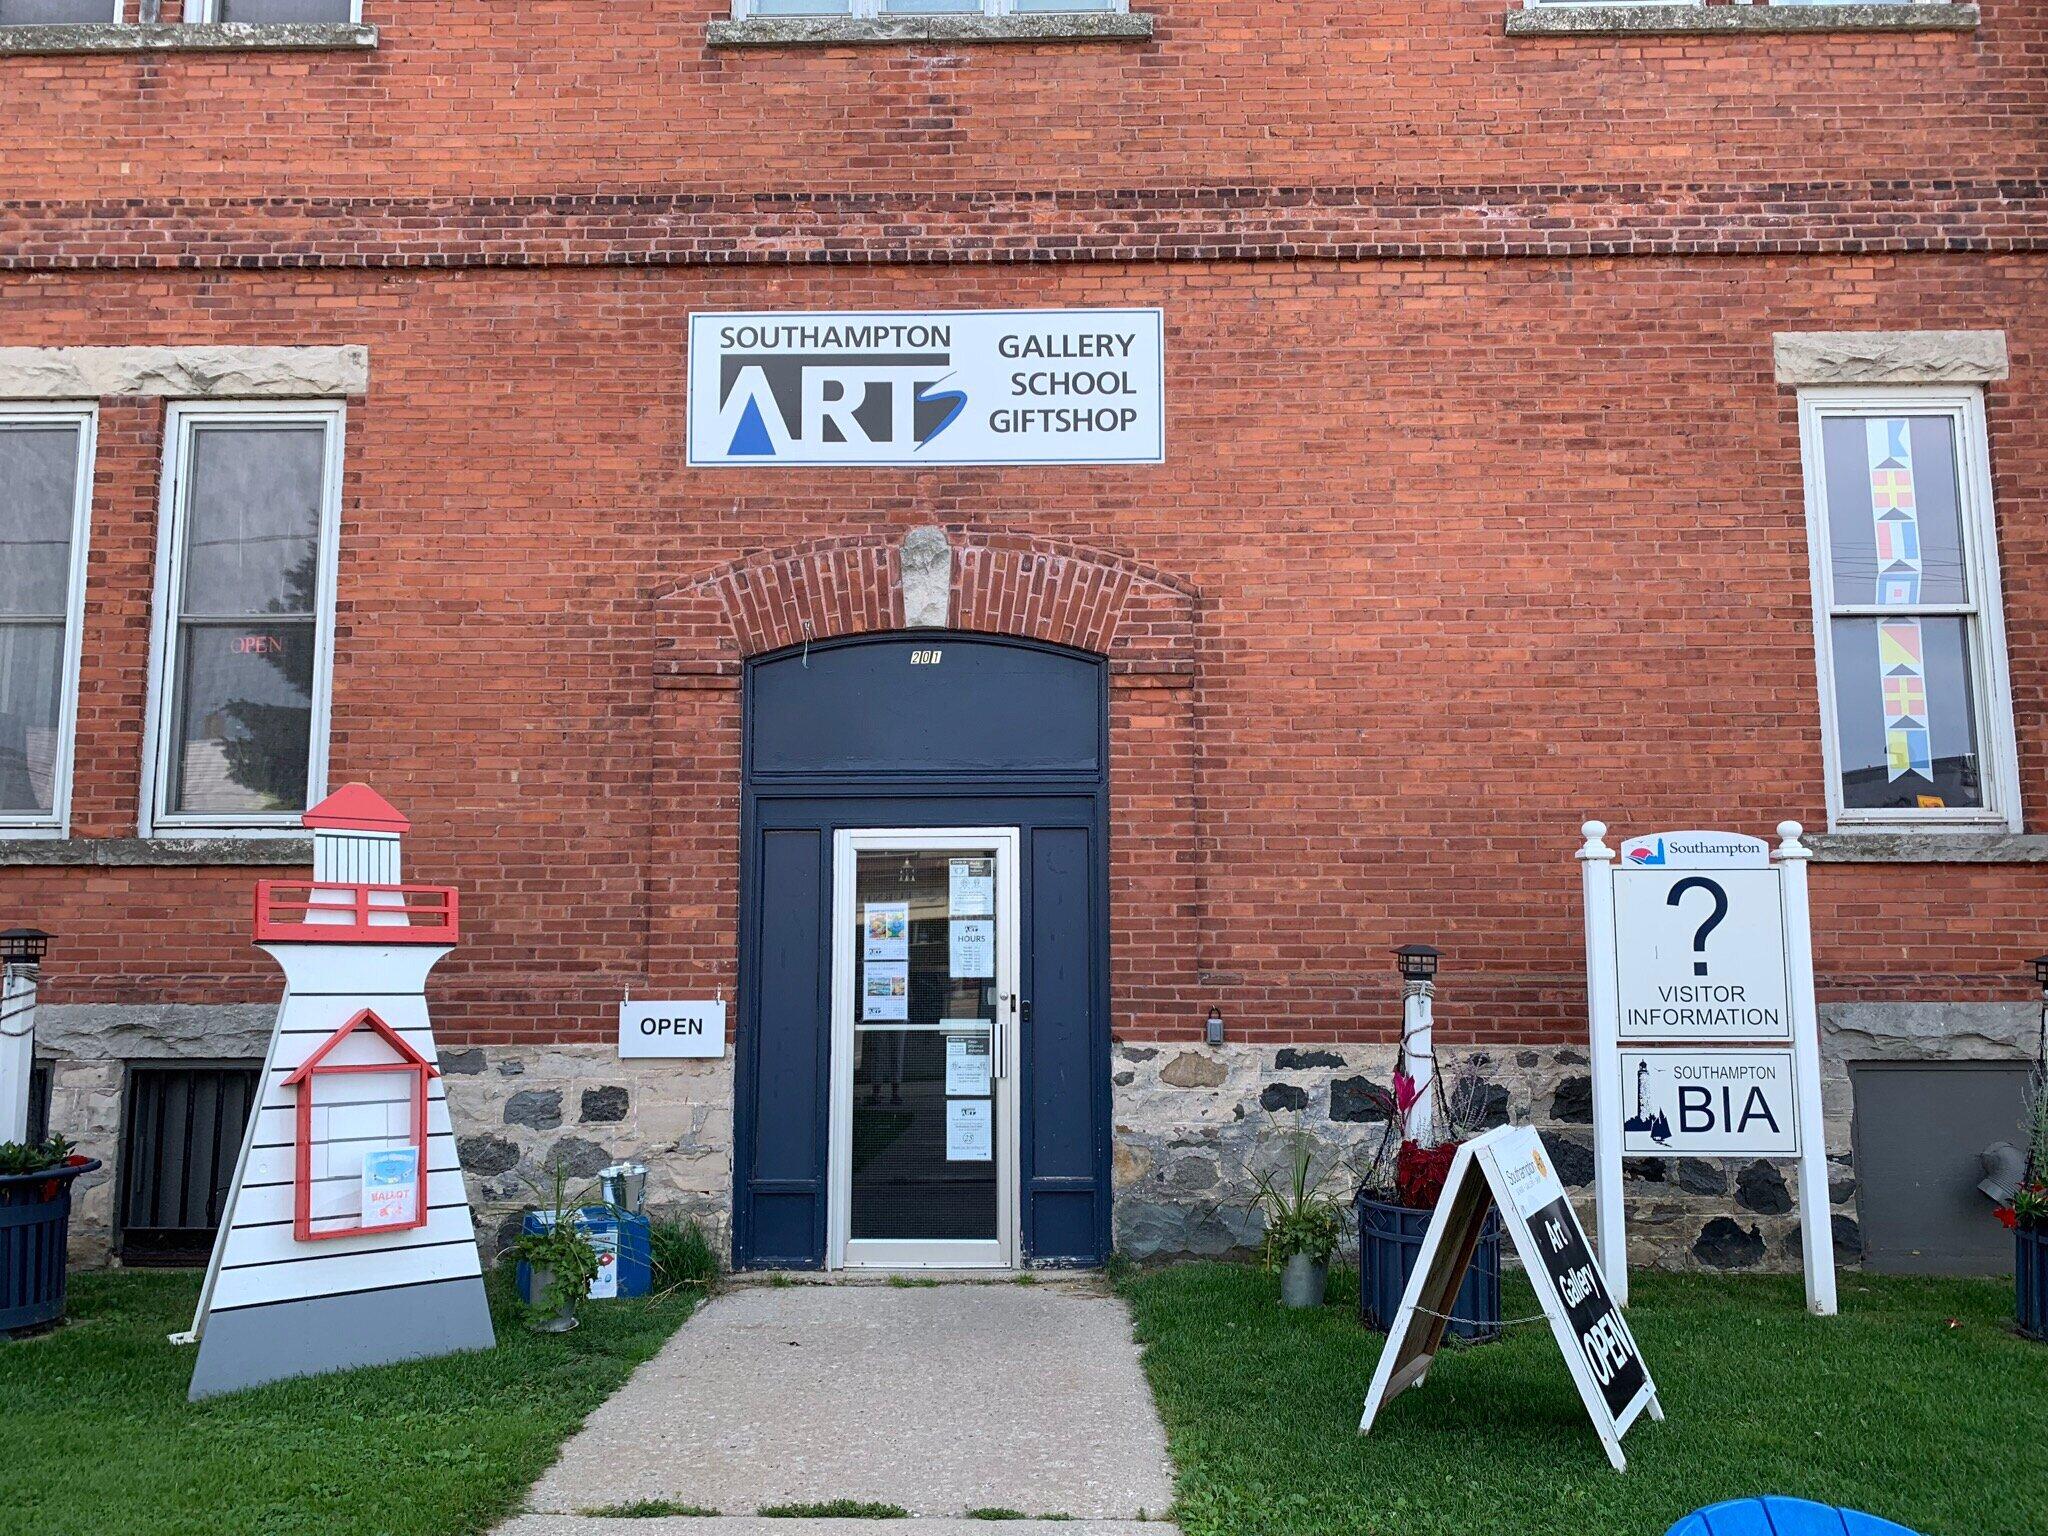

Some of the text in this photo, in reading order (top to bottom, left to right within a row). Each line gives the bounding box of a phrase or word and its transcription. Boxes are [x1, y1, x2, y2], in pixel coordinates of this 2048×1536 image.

[720, 325, 950, 348] SOUTHAMPTON
[998, 334, 1135, 358] GALLERY
[1011, 371, 1136, 396] SCHOOL
[720, 365, 968, 455] ARTS
[989, 408, 1137, 434] GIFTSHOP
[230, 635, 284, 654] OPEN
[911, 651, 941, 664] 201
[1669, 841, 1760, 857] Southampton
[957, 935, 986, 943] HOURS
[1658, 985, 1746, 1003] VISITOR
[640, 1017, 703, 1036] OPEN
[1627, 1008, 1779, 1026] INFORMATION
[1674, 1066, 1776, 1081] SOUTHAMPTON
[1678, 1085, 1781, 1133] BIA
[1545, 1220, 1570, 1253] Art
[1558, 1263, 1602, 1310] Gallery
[1583, 1307, 1635, 1386] OPEN
